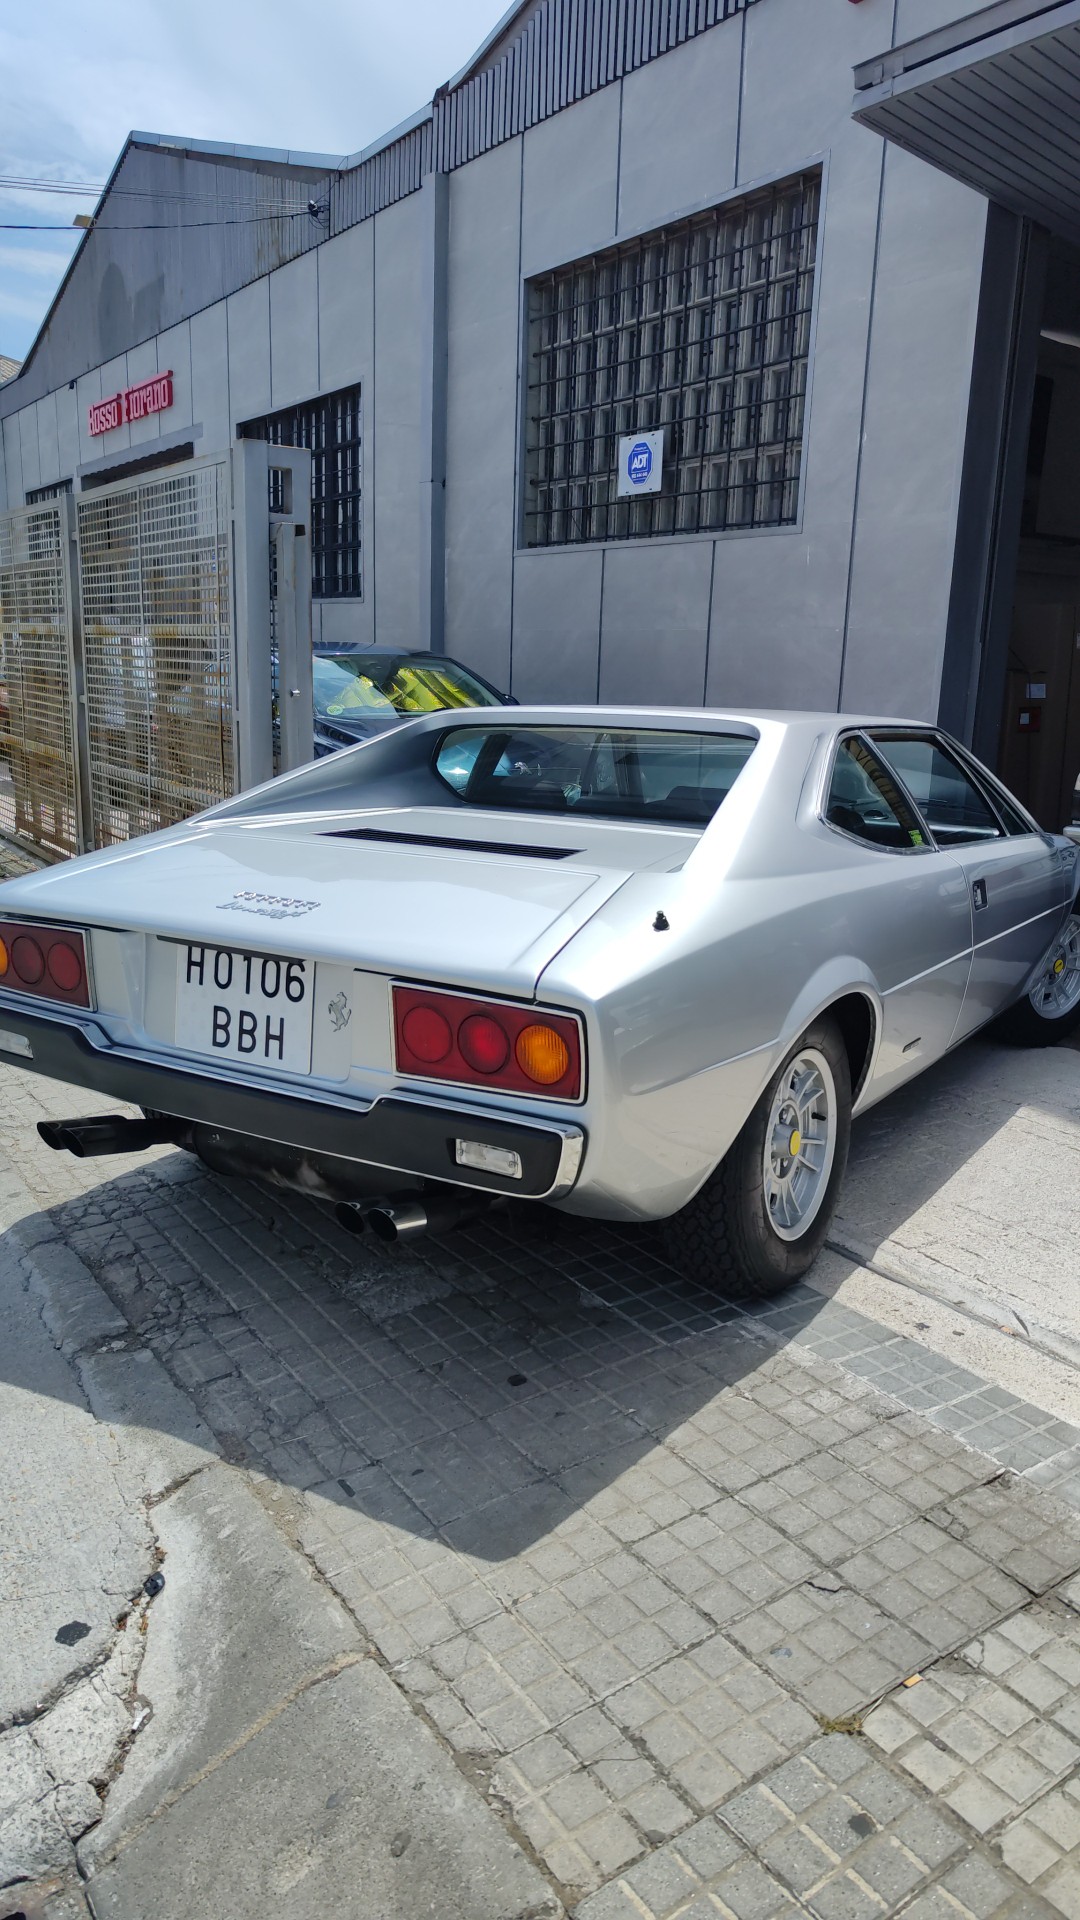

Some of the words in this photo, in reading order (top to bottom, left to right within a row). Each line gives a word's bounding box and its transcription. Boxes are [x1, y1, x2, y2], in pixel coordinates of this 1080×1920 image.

[88, 393, 122, 437] Rosso
[631, 453, 649, 470] ADT
[186, 946, 306, 1003] H0106
[212, 1005, 285, 1060] BBH
